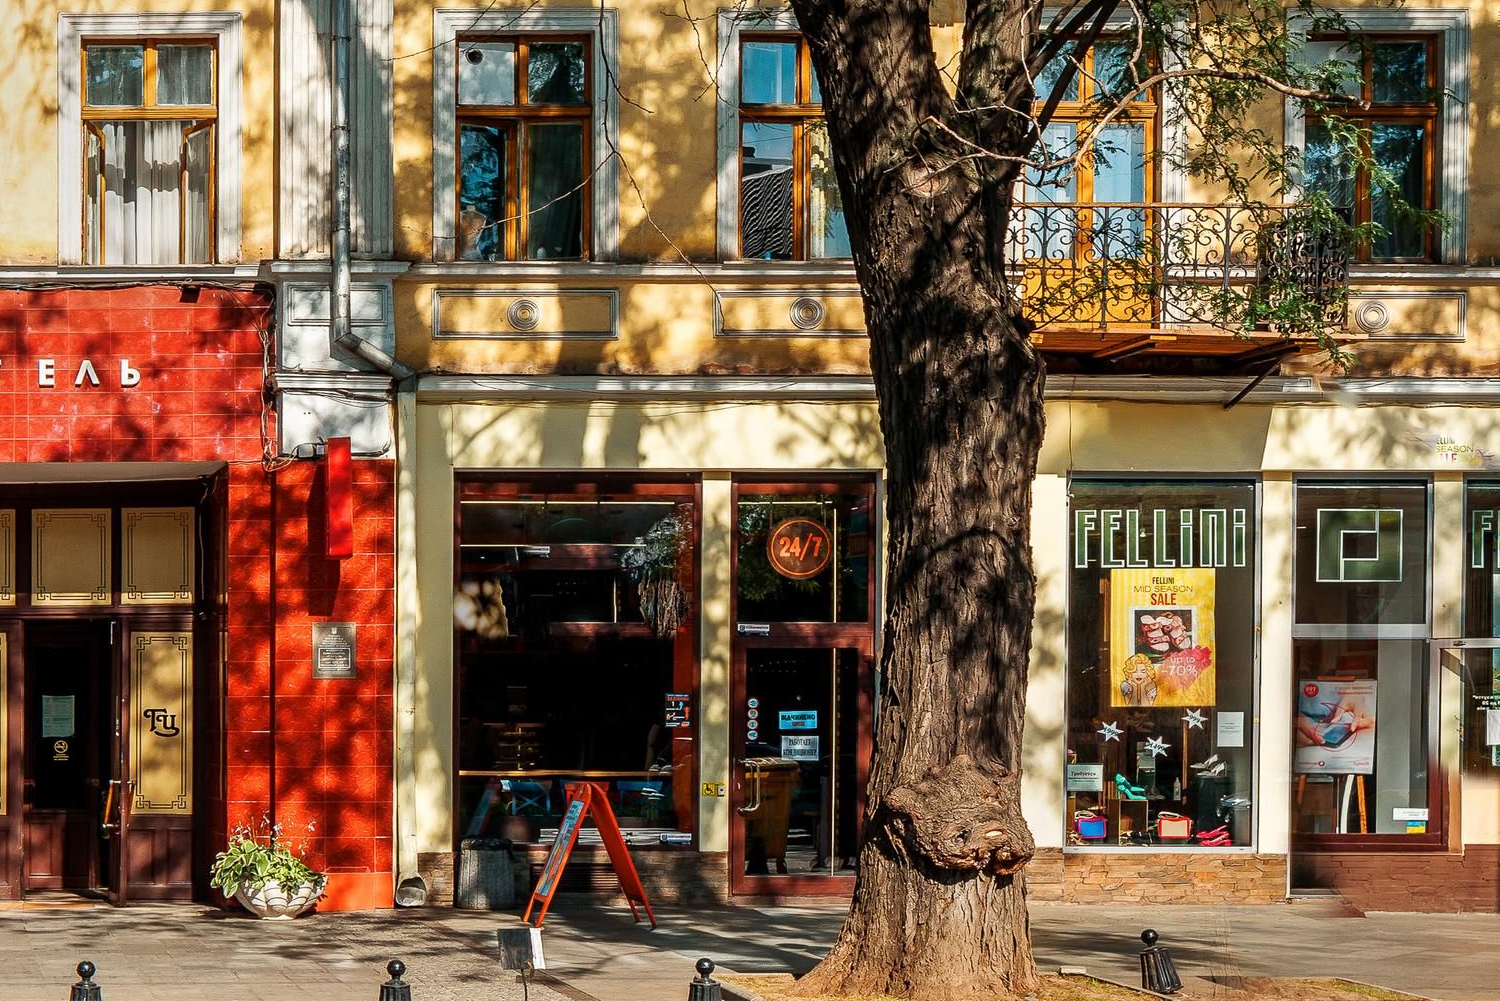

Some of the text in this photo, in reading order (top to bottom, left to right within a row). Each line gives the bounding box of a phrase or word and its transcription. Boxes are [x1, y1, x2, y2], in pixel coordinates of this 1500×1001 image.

[779, 532, 822, 561] 24/7
[1150, 593, 1177, 606] SALE
[1170, 656, 1196, 665] up to
[1161, 666, 1198, 676] -70%
